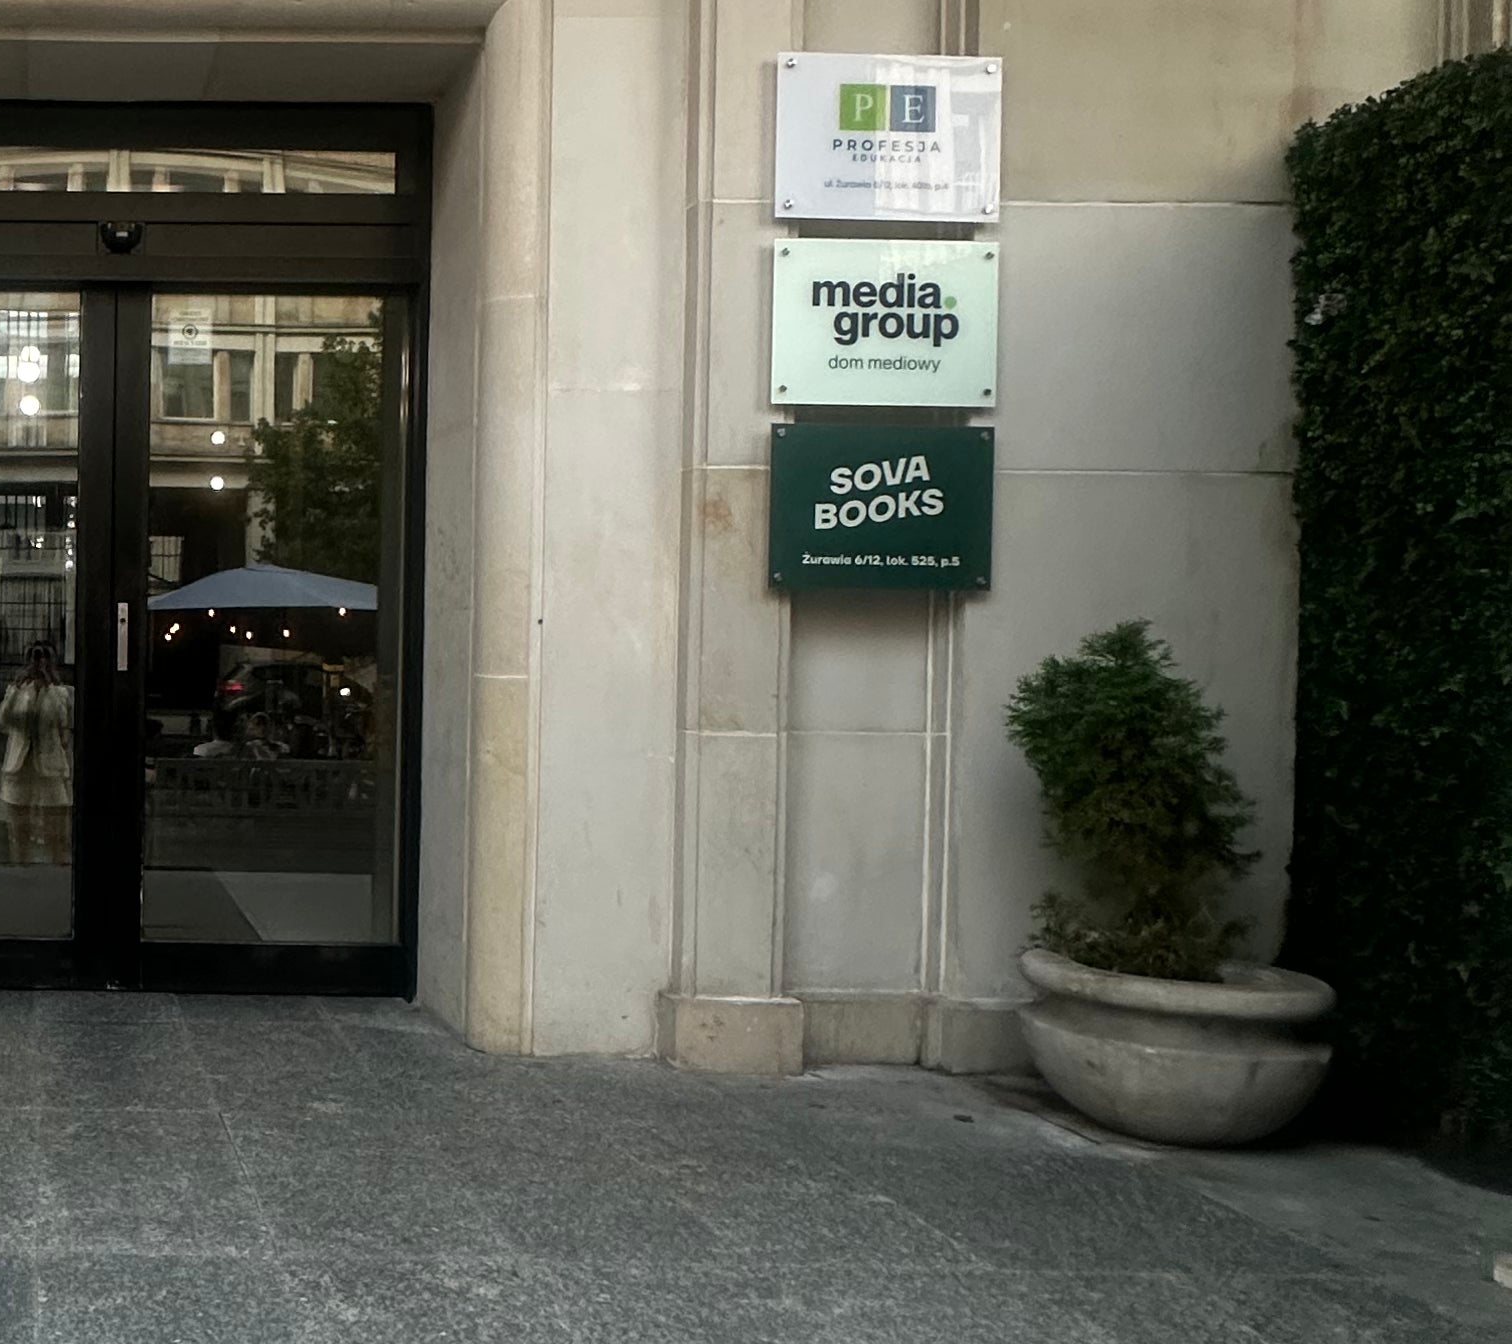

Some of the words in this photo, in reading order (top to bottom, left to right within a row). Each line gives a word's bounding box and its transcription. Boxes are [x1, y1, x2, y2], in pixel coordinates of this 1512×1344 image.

[832, 139, 942, 153] PROFESJA
[852, 154, 922, 163] EDUKACJA
[833, 311, 959, 347] group
[829, 355, 864, 369] dom
[867, 357, 941, 373] mediowy
[829, 455, 931, 495] SOVA
[814, 488, 944, 530] BOOKS
[801, 551, 852, 565] Żurawia
[854, 555, 883, 566] 6/12,
[886, 555, 908, 565] lok.
[911, 556, 938, 567] 525,
[941, 557, 961, 567] p.5
